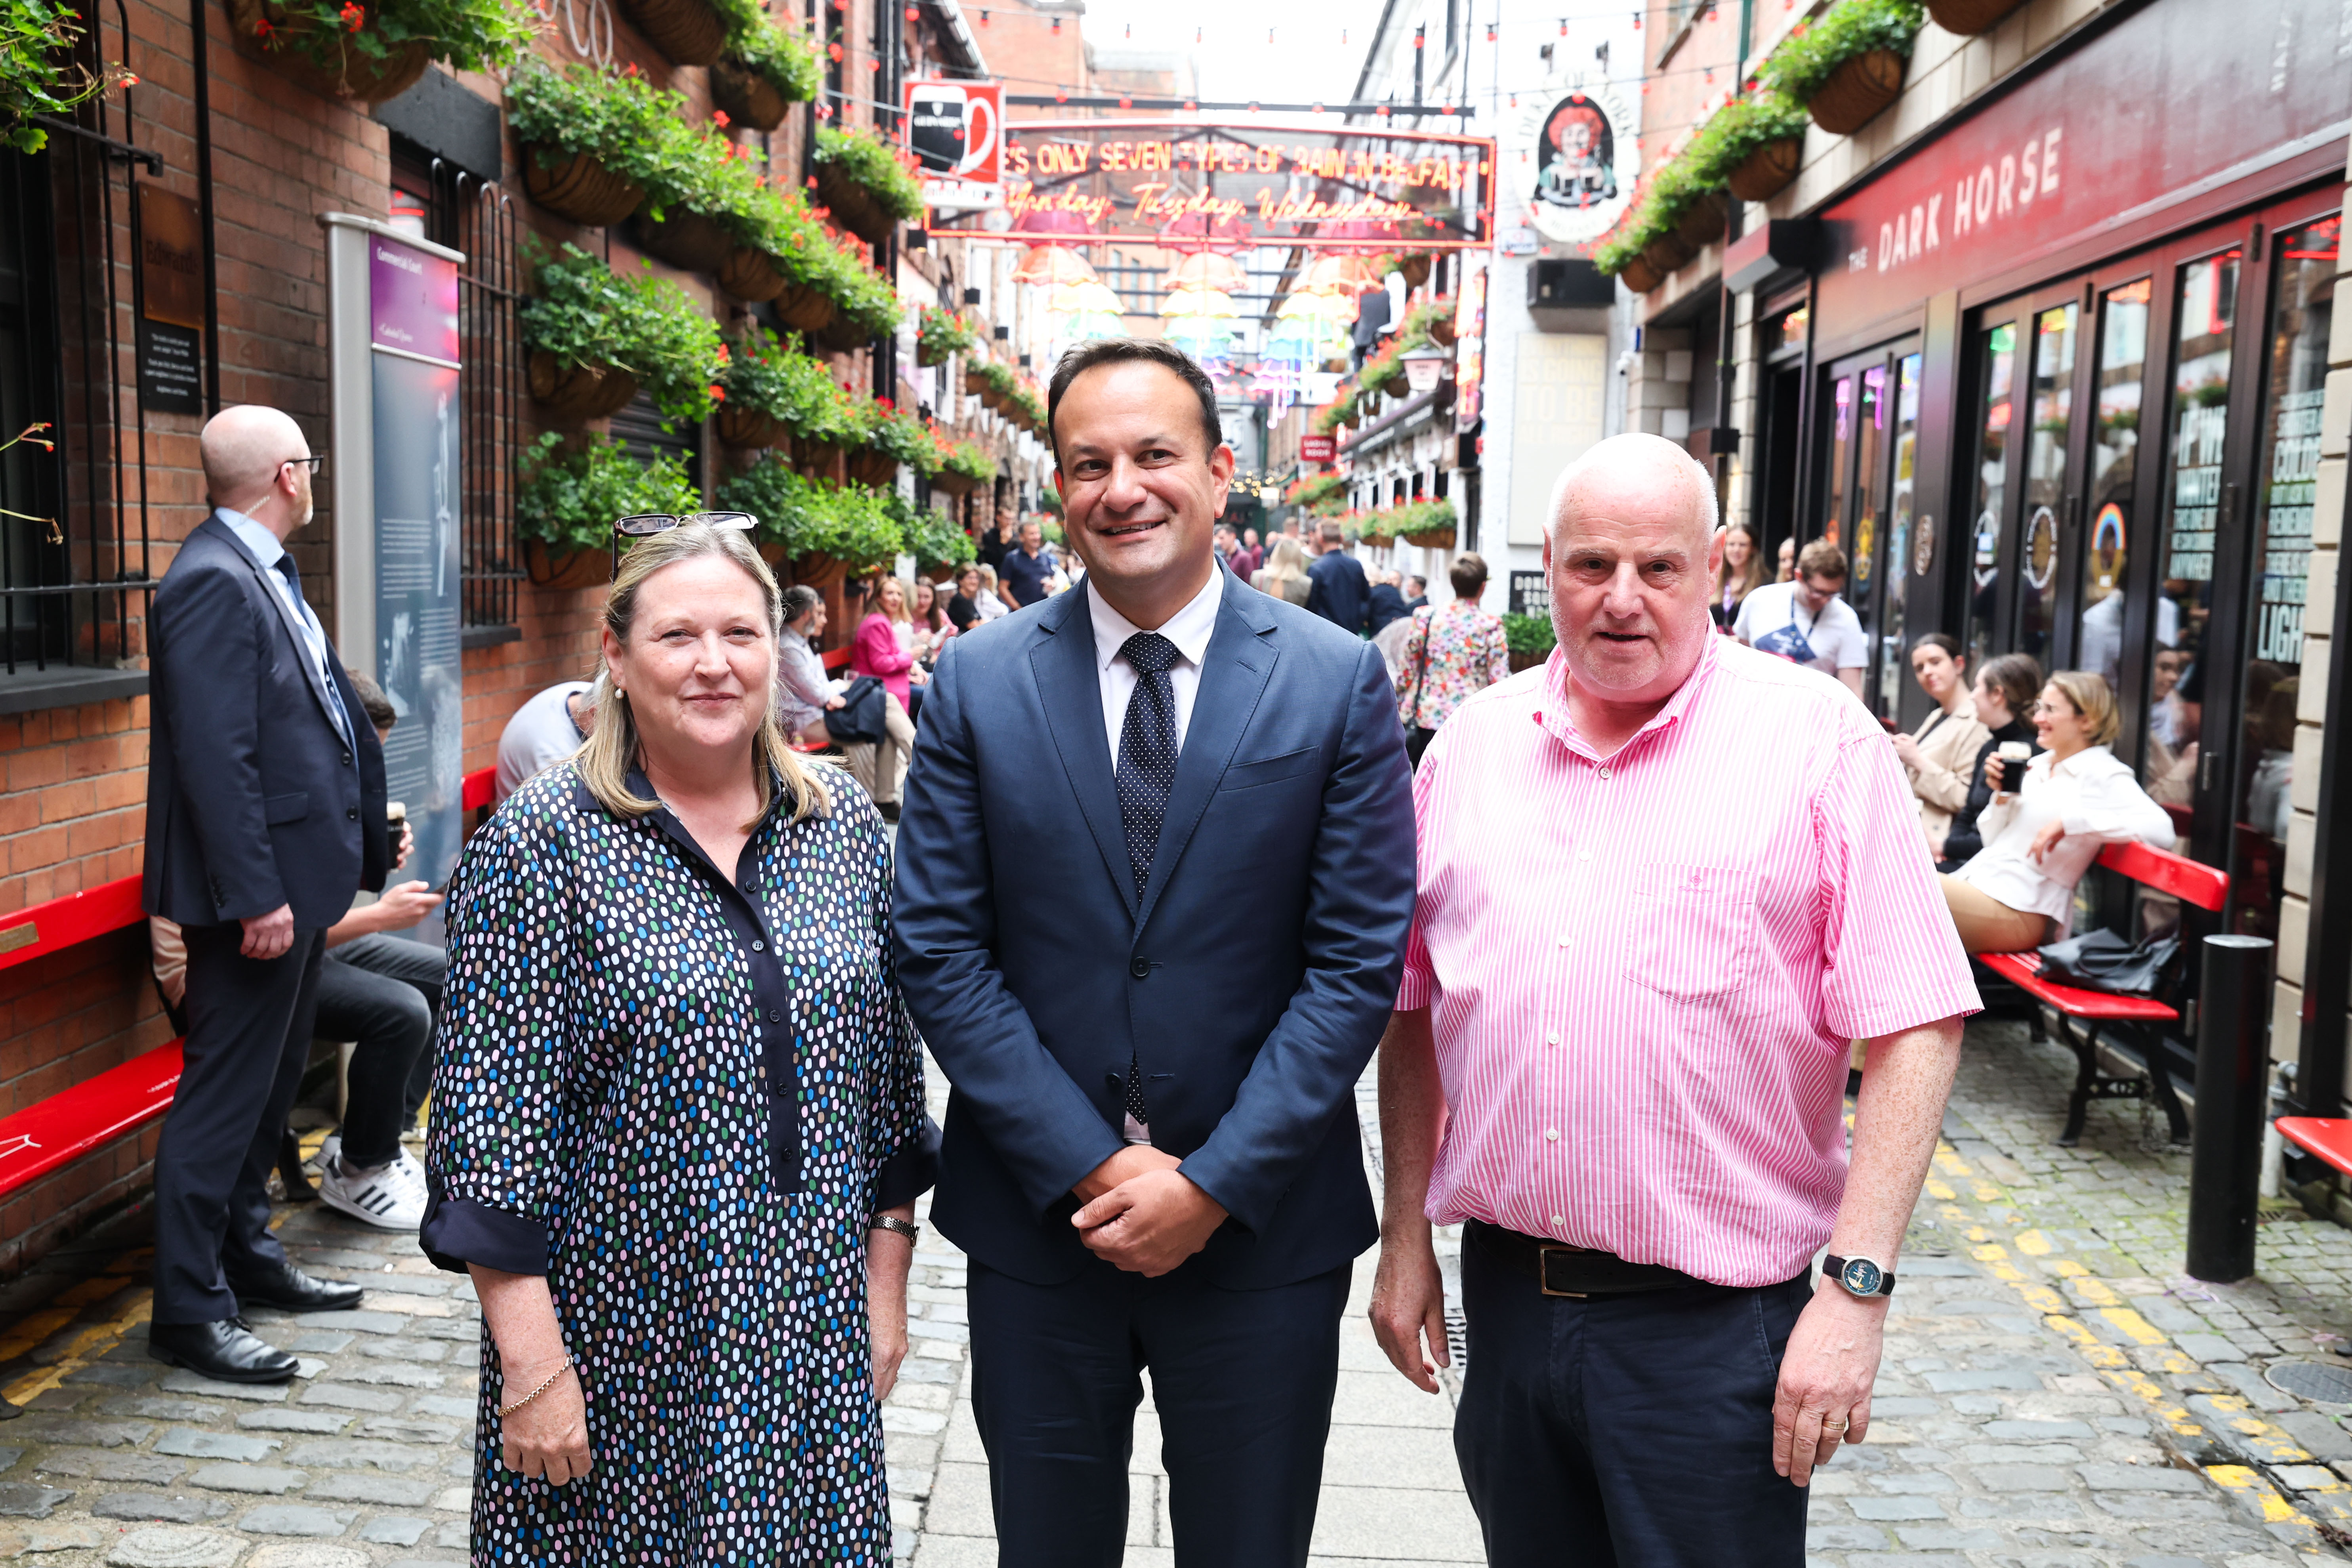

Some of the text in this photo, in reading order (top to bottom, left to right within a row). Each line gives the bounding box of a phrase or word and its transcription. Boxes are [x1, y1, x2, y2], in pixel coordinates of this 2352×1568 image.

[1037, 143, 1091, 174] ONLY
[1100, 141, 1171, 172] SEVEN
[1255, 144, 1286, 174] OF
[1848, 127, 2062, 274] THE DARK HORSE
[1521, 384, 1600, 423] TO BE
[2257, 602, 2306, 664] LIGH
